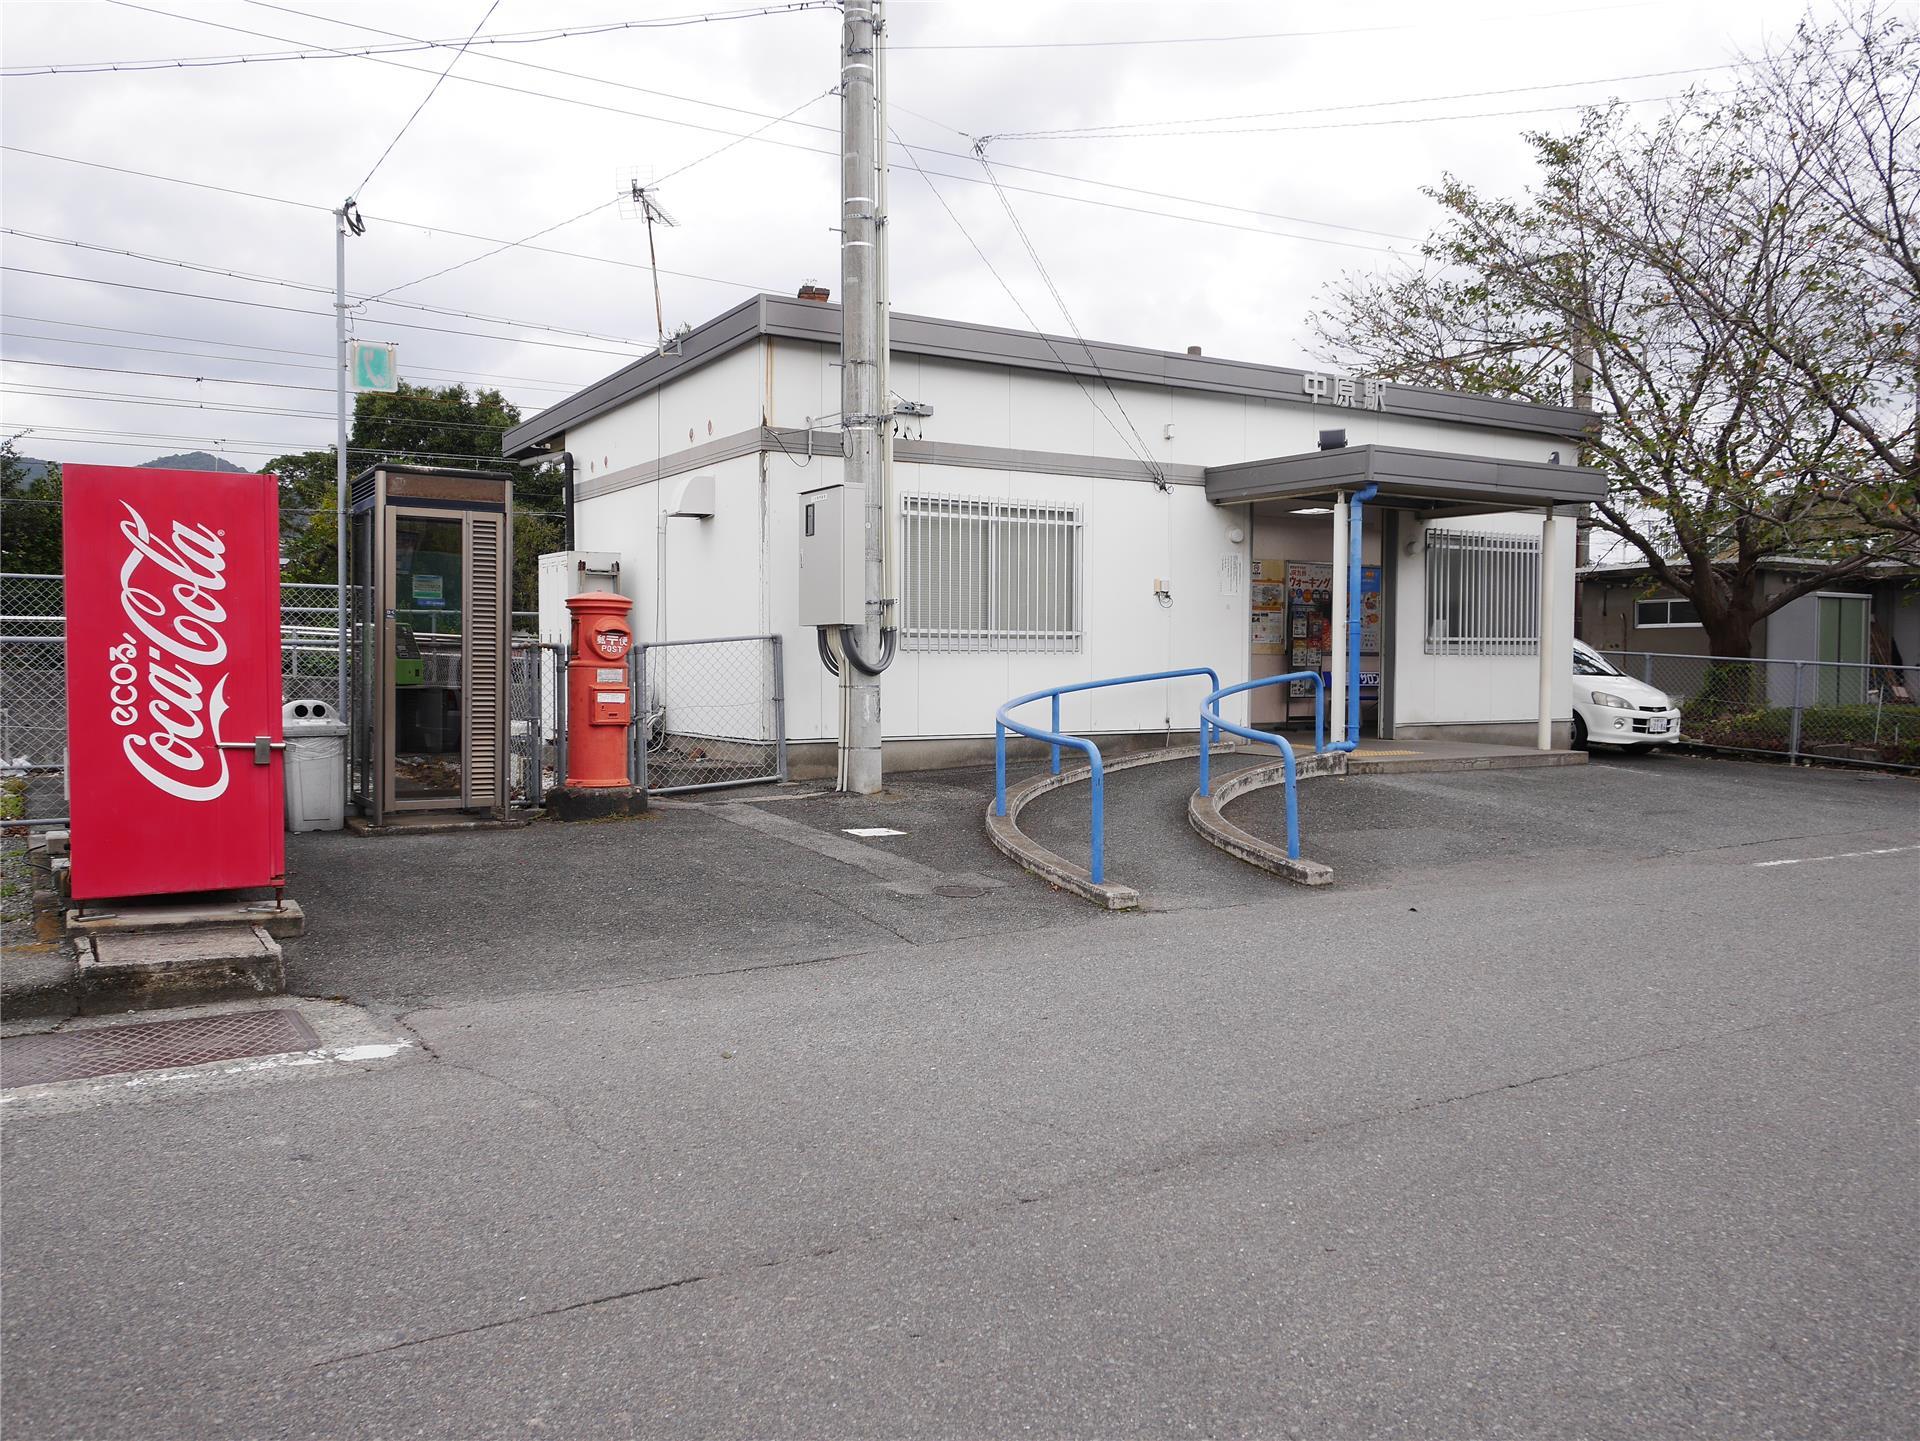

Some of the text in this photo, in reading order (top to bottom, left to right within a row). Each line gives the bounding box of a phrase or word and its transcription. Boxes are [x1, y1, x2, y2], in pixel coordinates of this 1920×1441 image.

[1303, 370, 1387, 412] 中原駅
[1289, 576, 1331, 588] ウォーキング
[119, 499, 229, 802] Coca-Cola
[601, 645, 623, 653] POST
